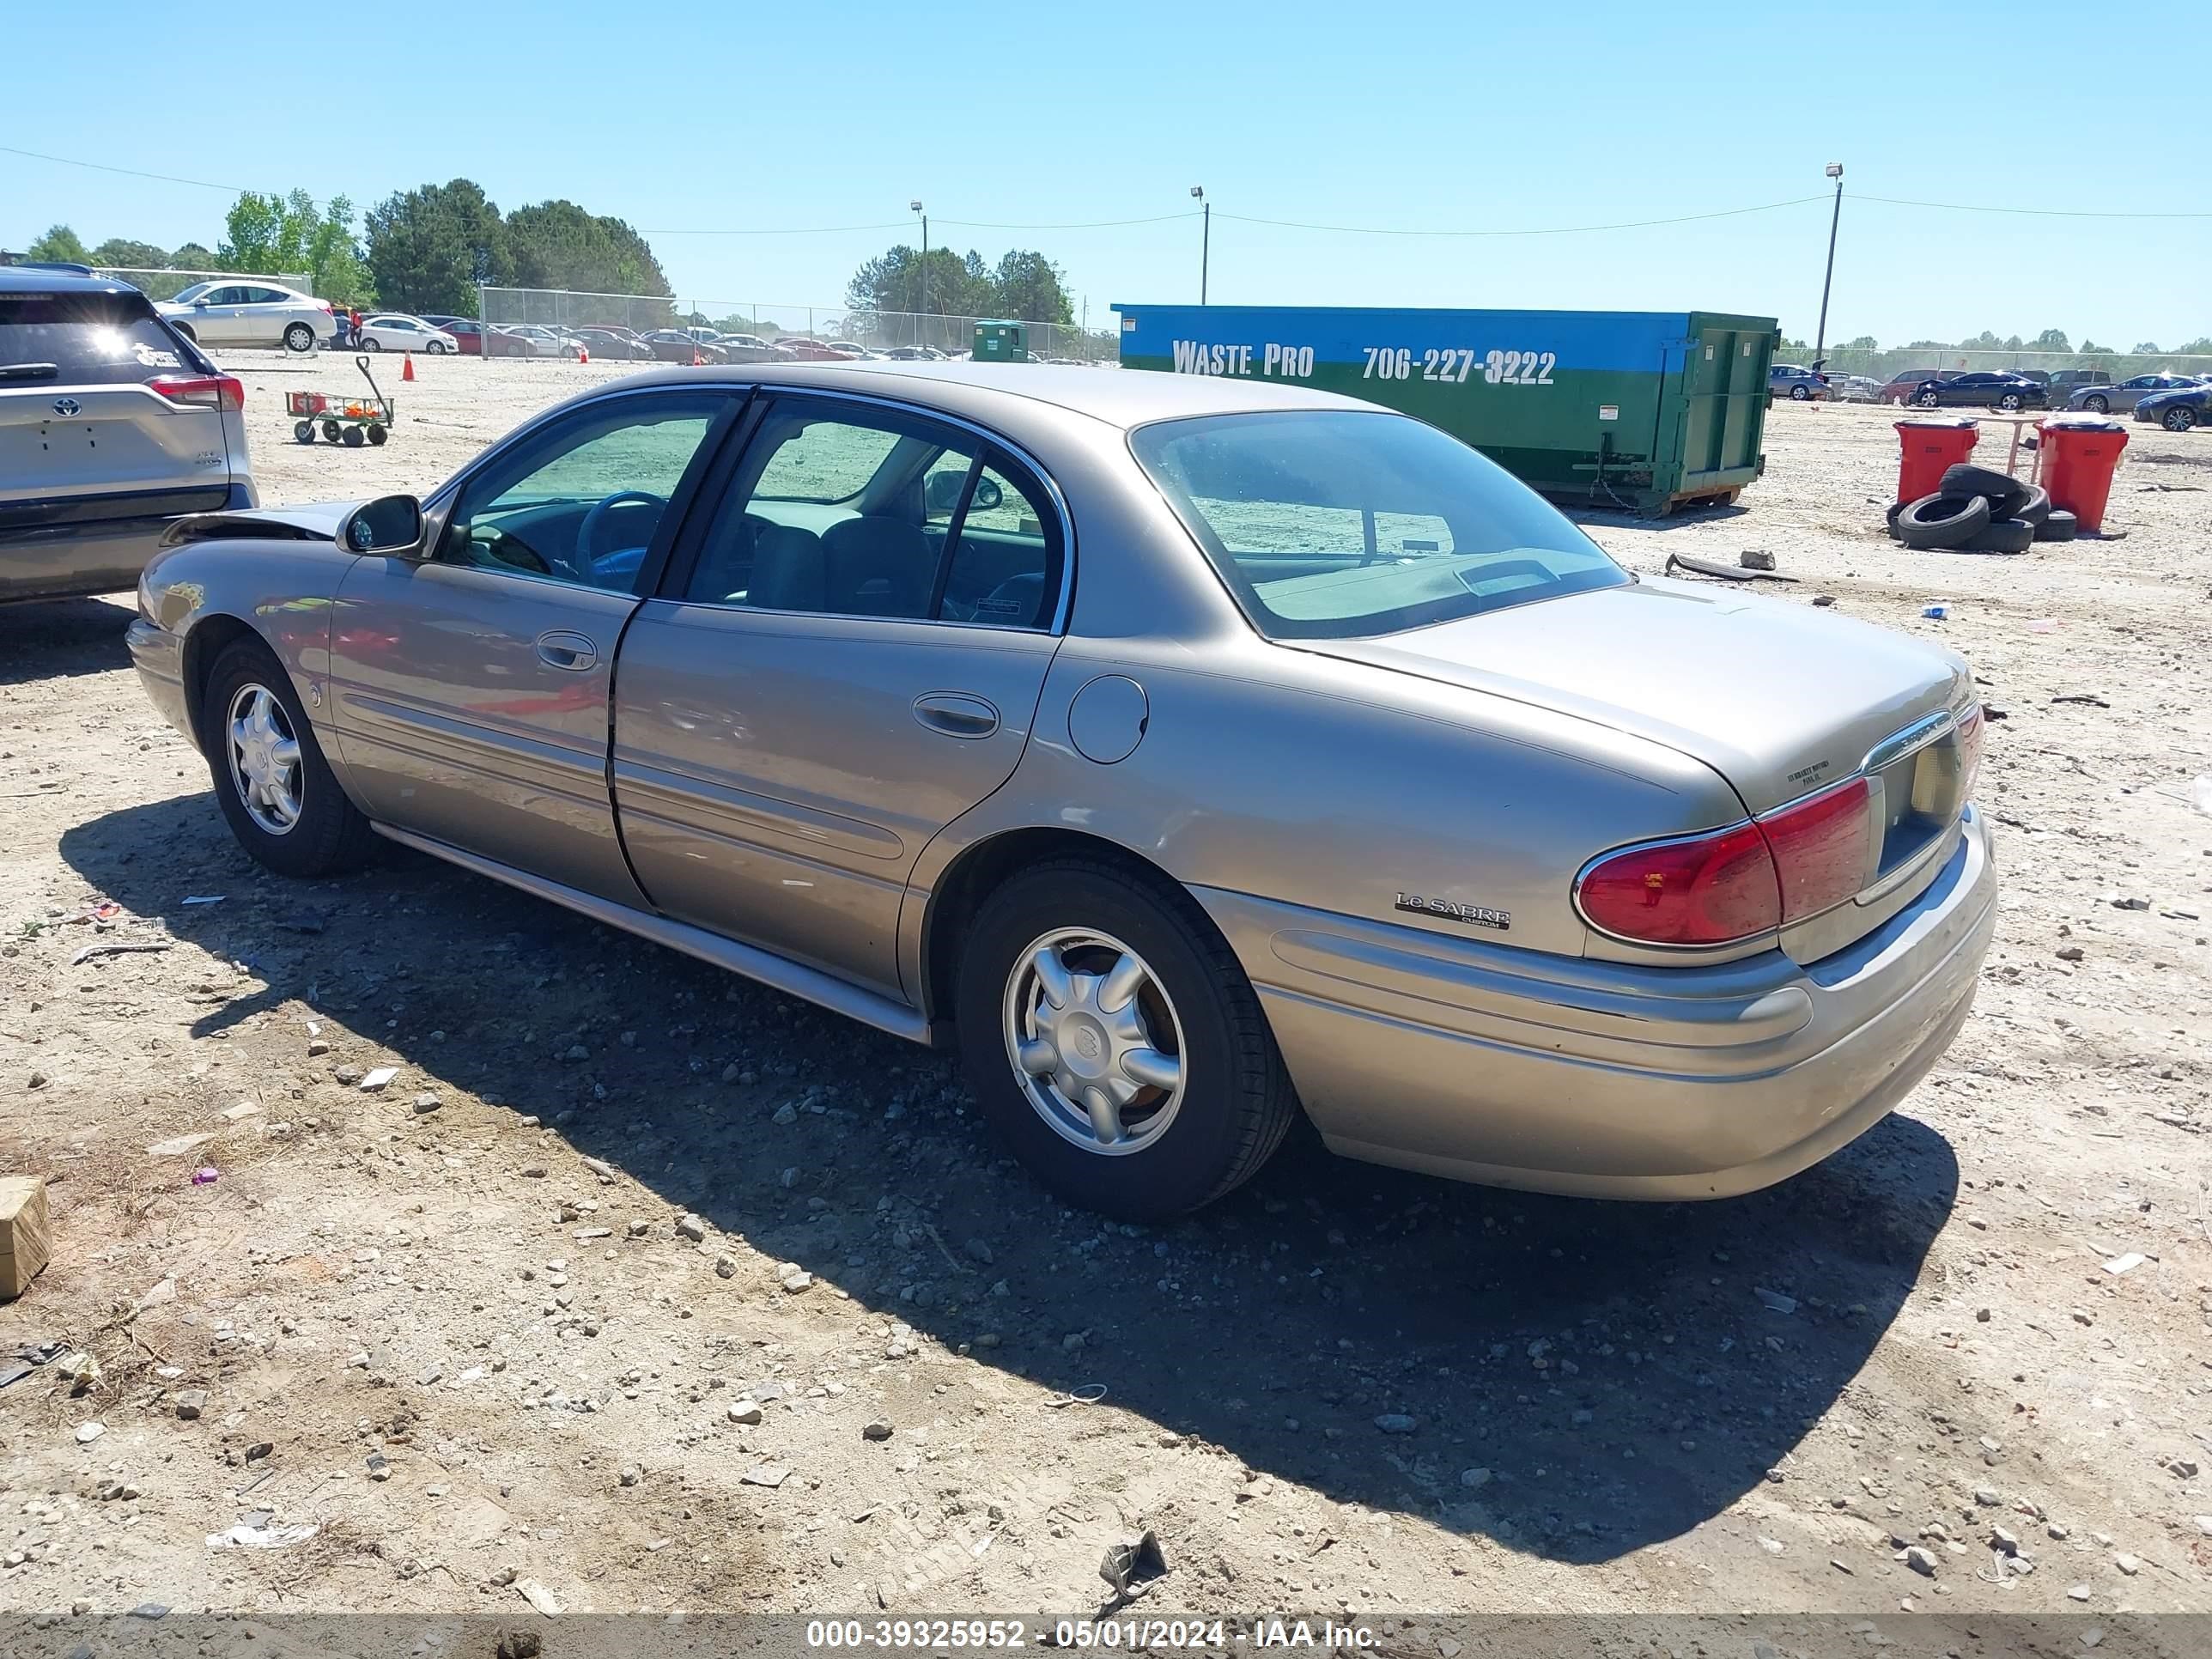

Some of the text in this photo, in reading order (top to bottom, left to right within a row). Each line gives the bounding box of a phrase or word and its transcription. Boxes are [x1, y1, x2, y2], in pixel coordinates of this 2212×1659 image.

[1362, 347, 1557, 385] 706-227-3222
[1429, 898, 1510, 924] SABRE
[1461, 916, 1499, 928] CUSTOM
